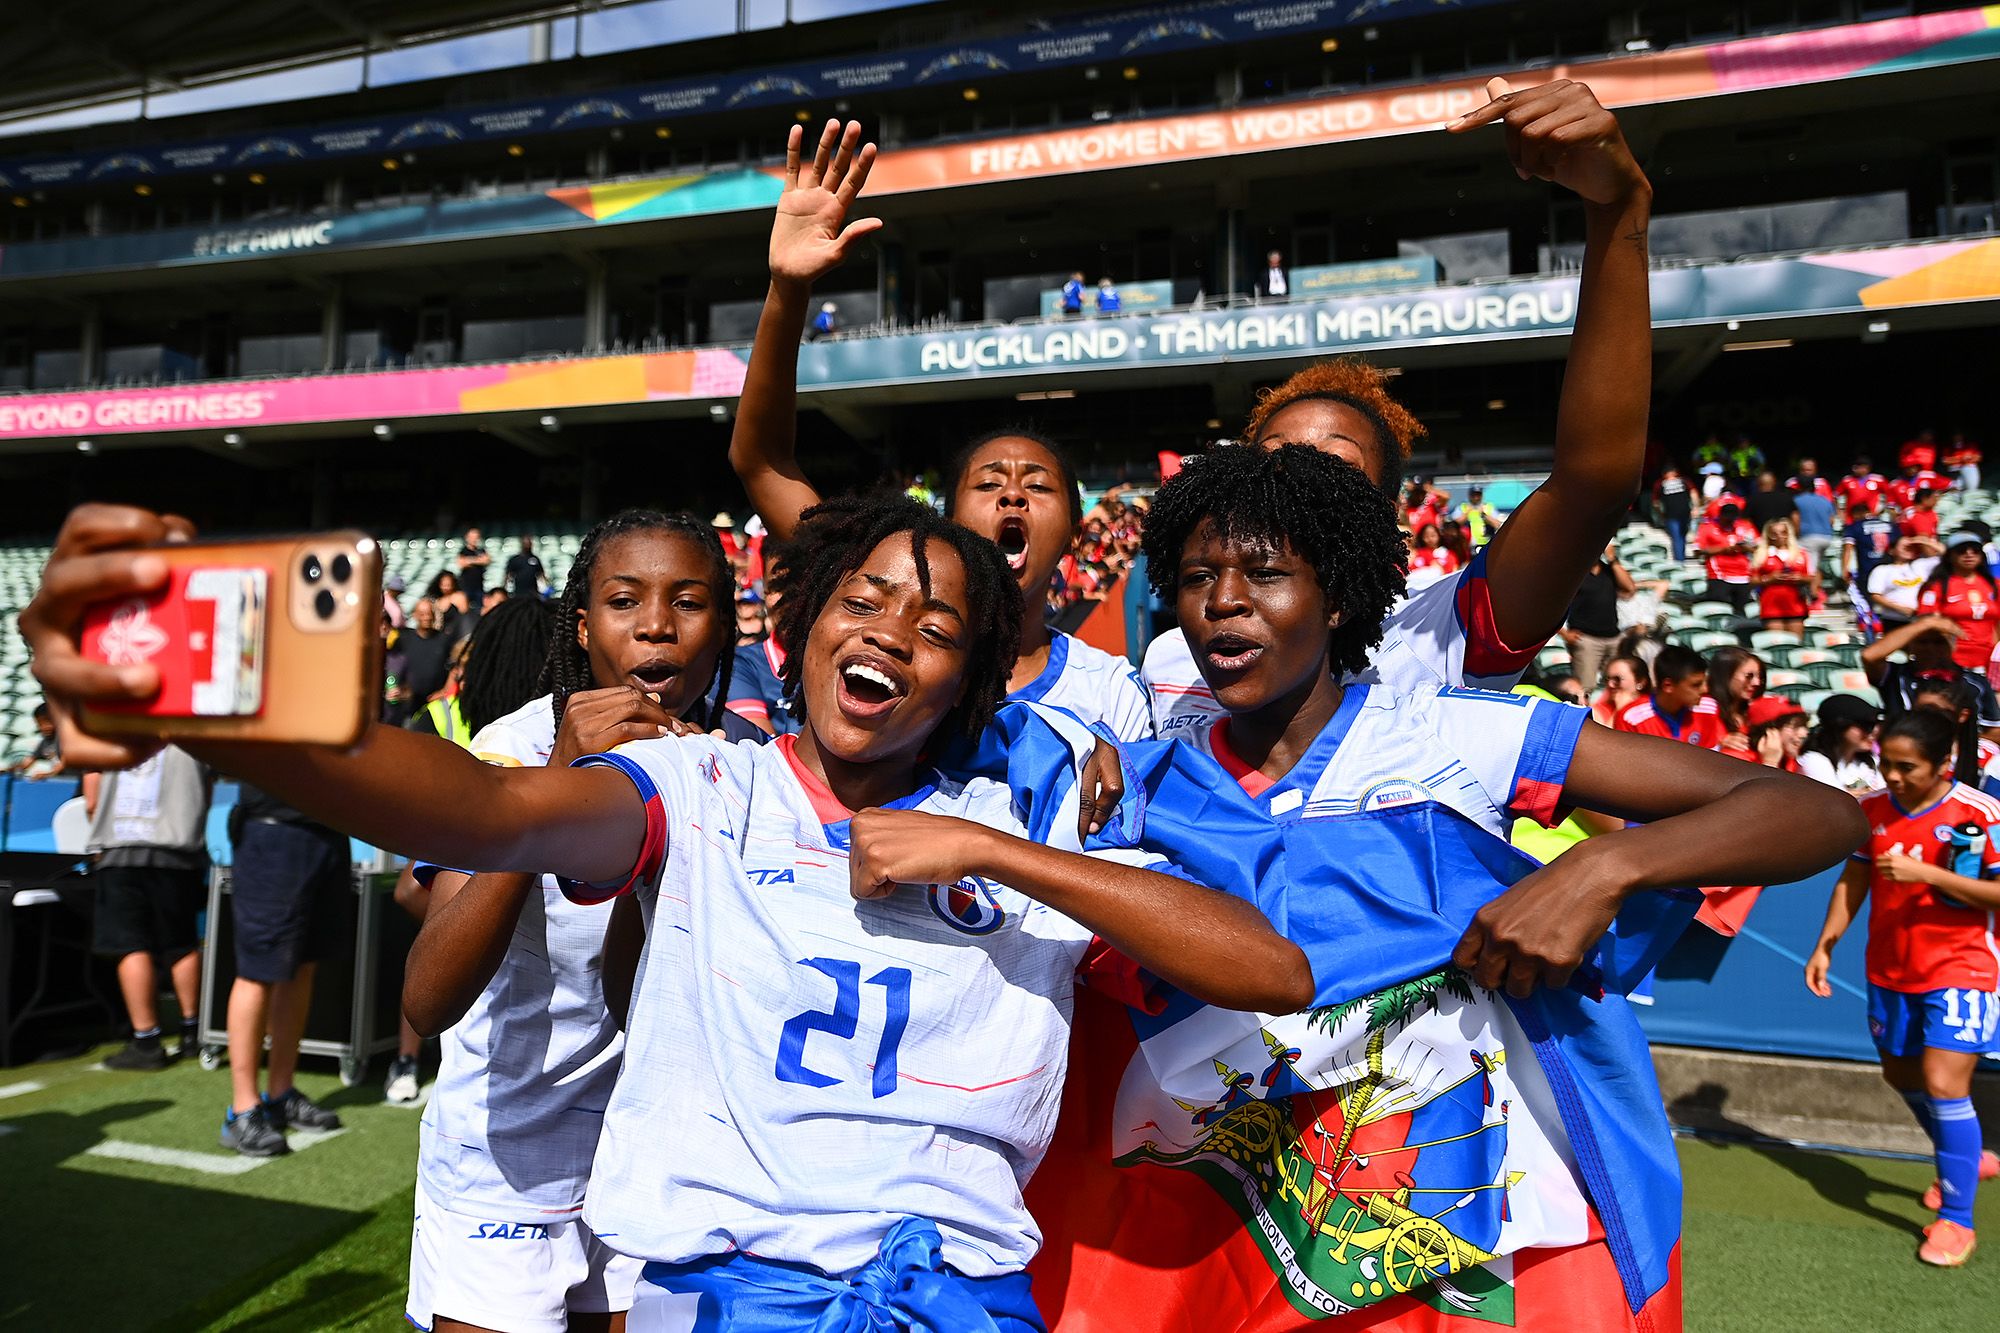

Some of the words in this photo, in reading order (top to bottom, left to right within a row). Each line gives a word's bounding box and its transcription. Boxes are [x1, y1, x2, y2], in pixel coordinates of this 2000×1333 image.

[970, 143, 1041, 174] FIFA
[1047, 119, 1227, 165] WOMEN'S
[1231, 101, 1374, 143] WORLD
[193, 219, 335, 256] #FIFAWWC
[920, 327, 1128, 372] AUCKLAND
[1151, 312, 1306, 355] TĀMAKI
[1316, 289, 1576, 343] MAKAURAU
[746, 869, 795, 886] TA
[956, 880, 975, 893] AITI
[775, 956, 912, 1099] 21
[1942, 987, 1982, 1029] 11
[468, 1222, 549, 1240] SAETA
[1250, 1190, 1283, 1249] L'UNION
[1291, 1271, 1307, 1296] LA
[1312, 1290, 1350, 1315] FOR
